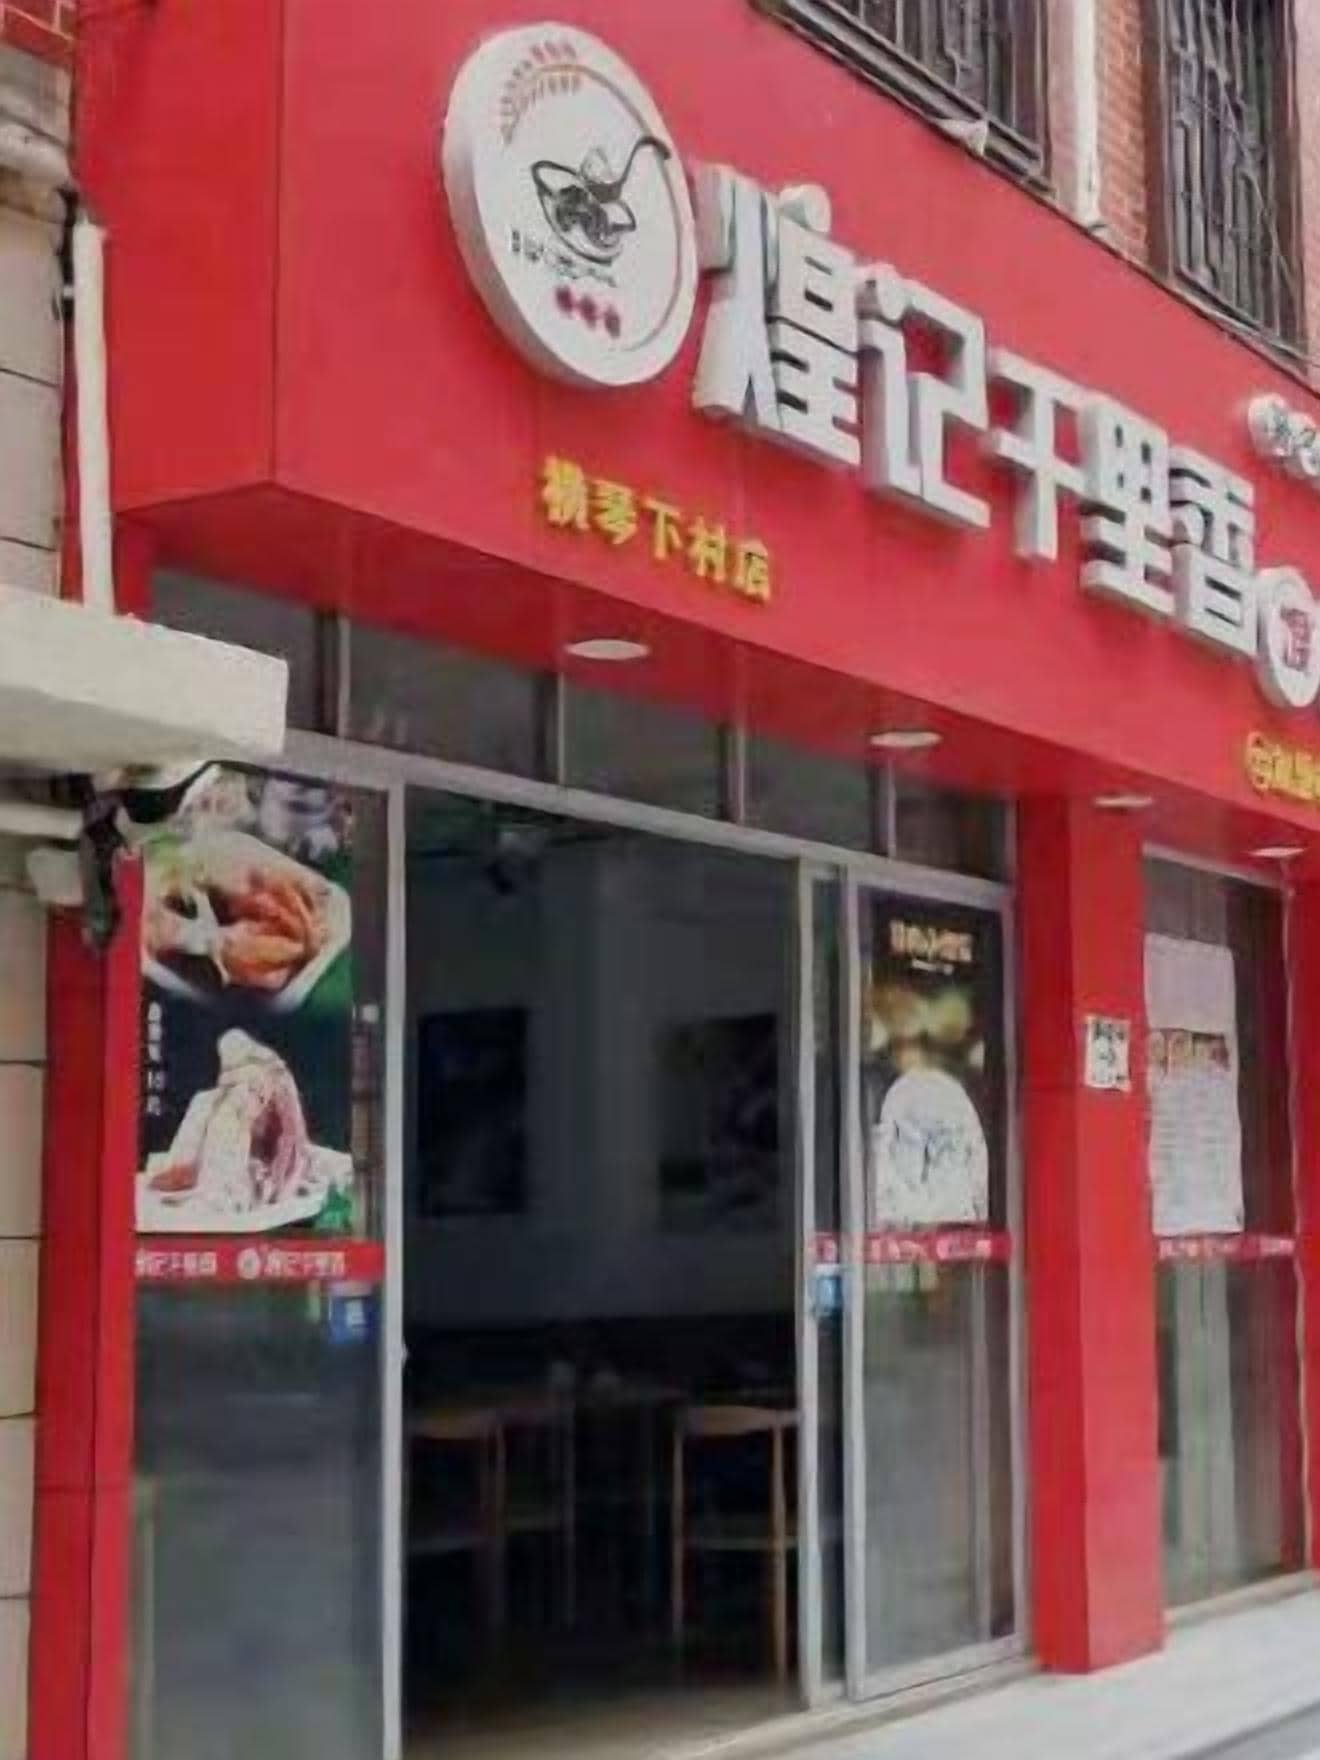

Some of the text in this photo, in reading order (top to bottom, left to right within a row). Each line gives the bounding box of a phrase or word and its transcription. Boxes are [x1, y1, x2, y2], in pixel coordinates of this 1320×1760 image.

[540, 453, 771, 602] 横琴下村店
[692, 165, 1257, 657] 煌记千里香
